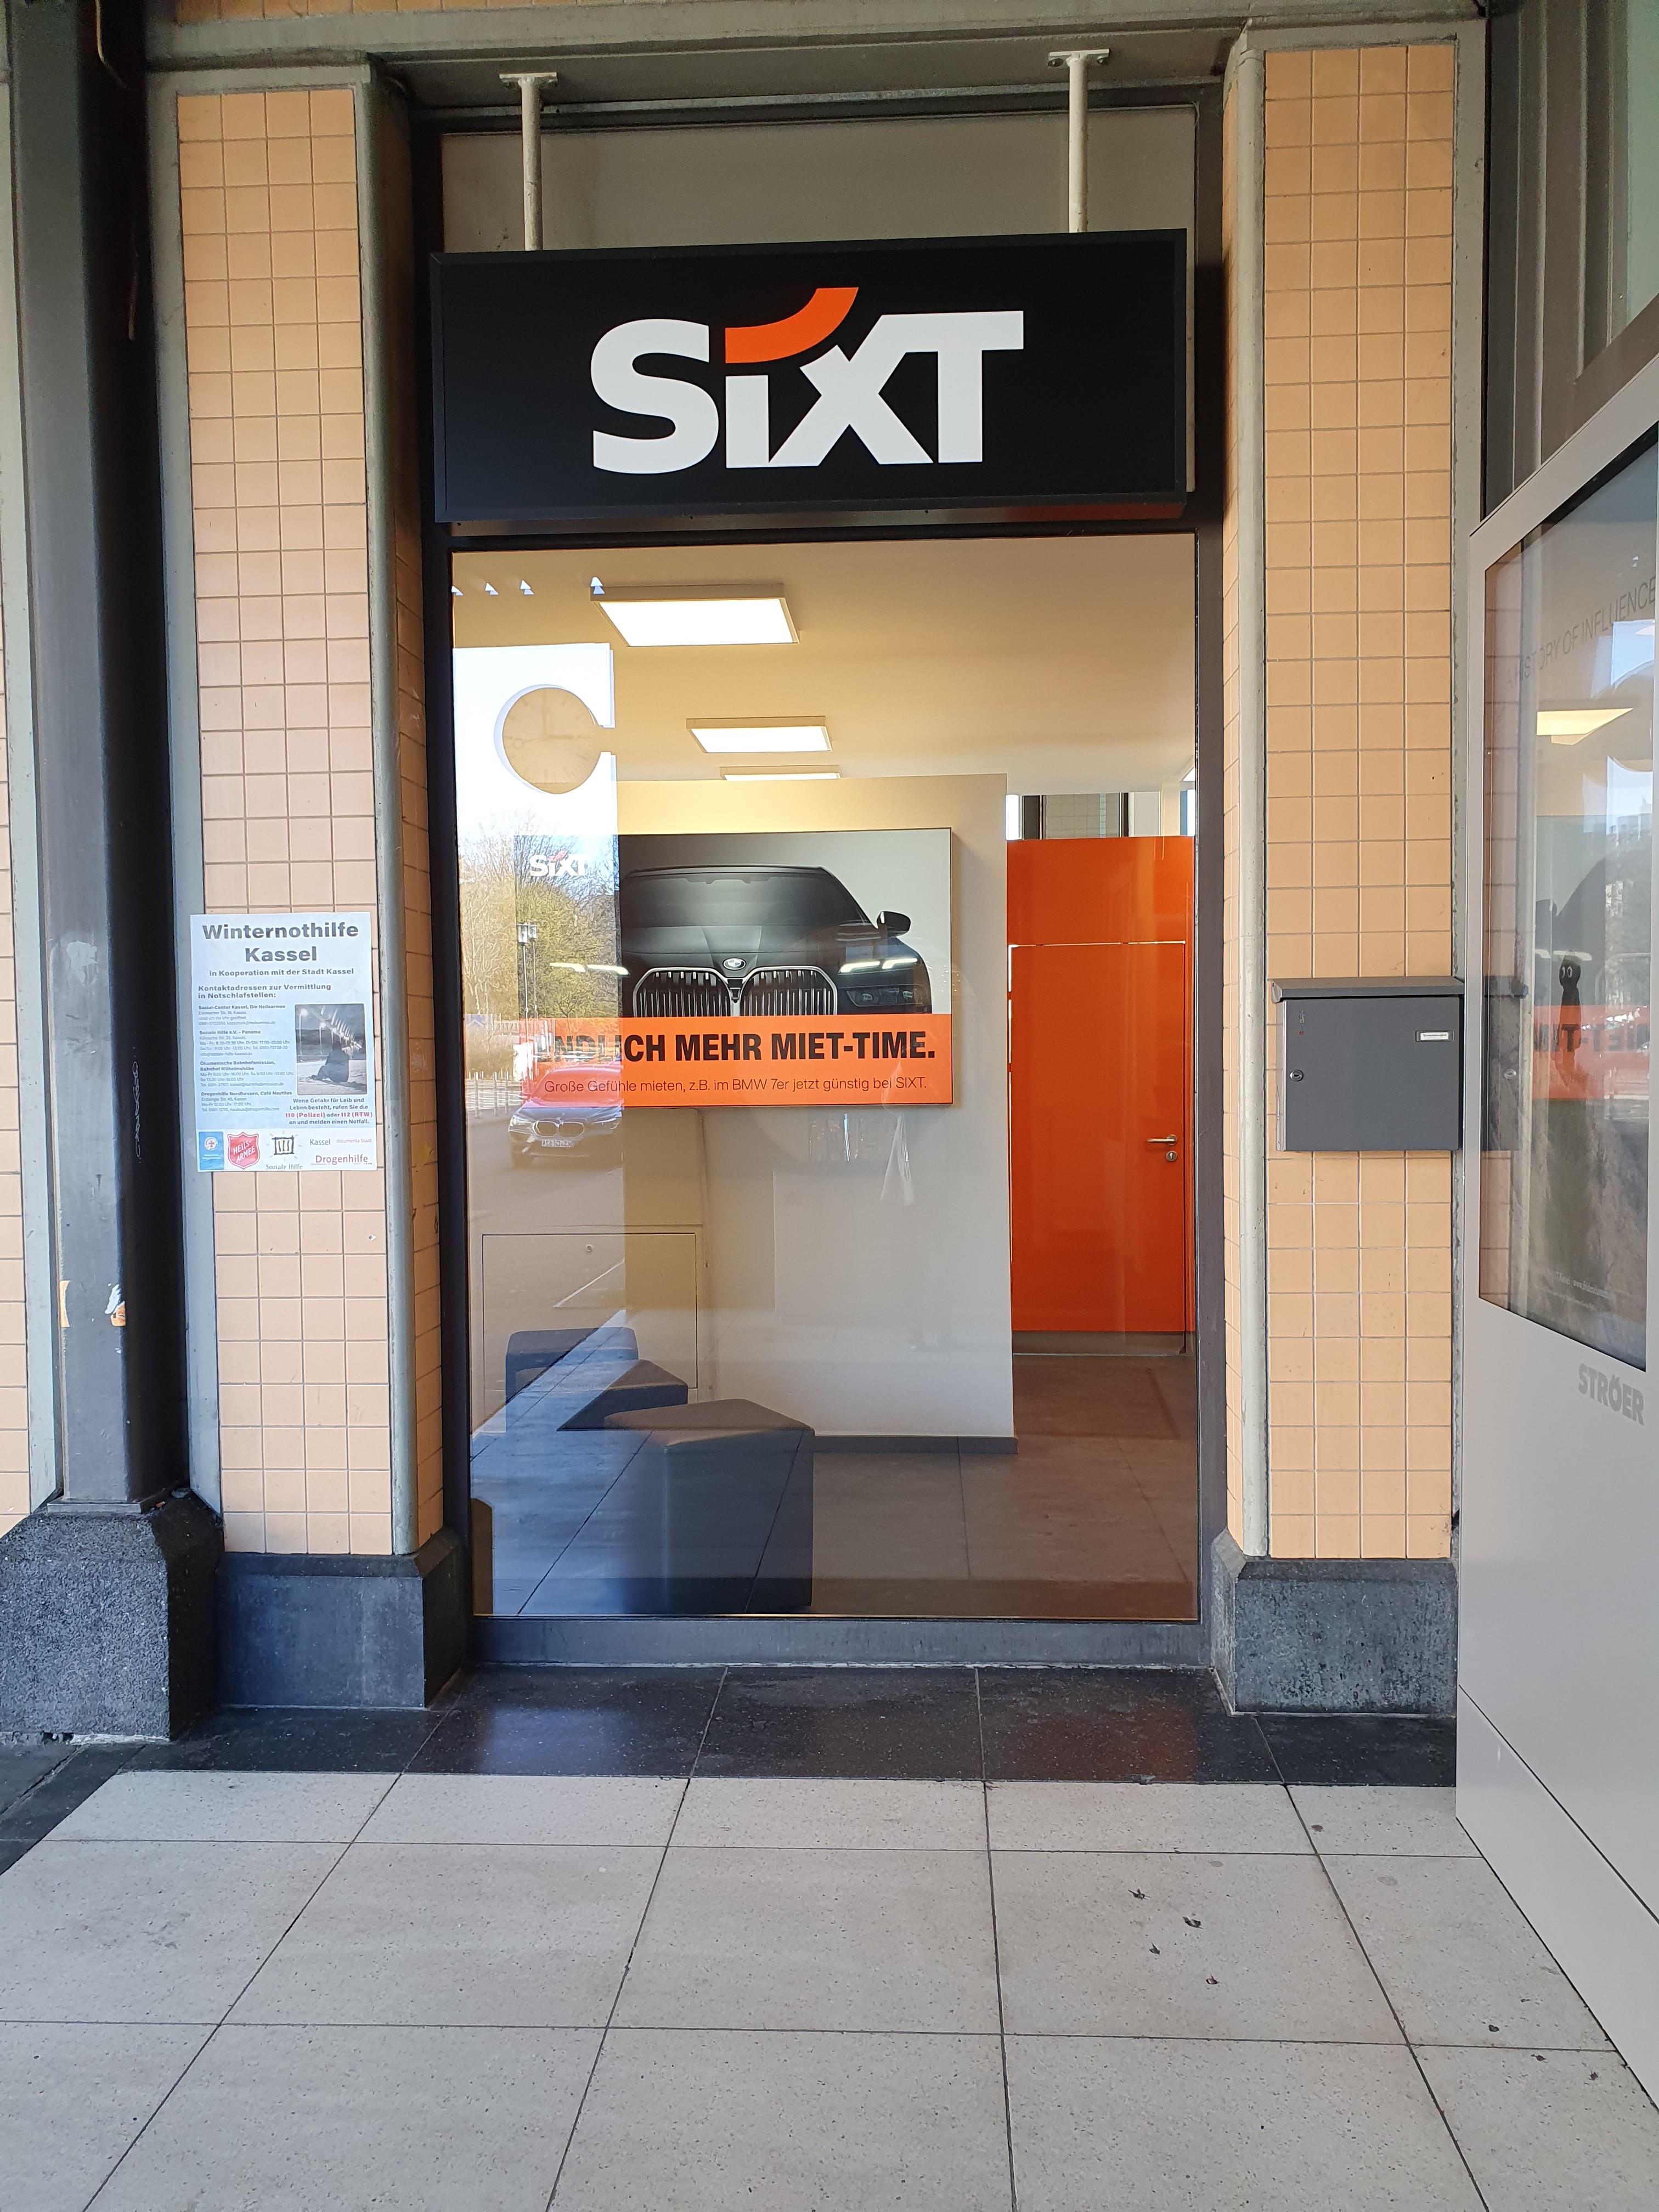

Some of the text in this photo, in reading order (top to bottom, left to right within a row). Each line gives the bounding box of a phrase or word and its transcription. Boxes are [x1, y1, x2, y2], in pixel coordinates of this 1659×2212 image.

[1563, 624, 1578, 654] OF
[1582, 575, 1656, 644] INFLUENCE
[202, 922, 359, 939] Winternothilfe
[245, 946, 317, 962] Kassel
[219, 969, 269, 978] Kooperation
[675, 1034, 761, 1061] MEHR
[771, 1031, 935, 1060] MIET-TIME.
[544, 1076, 927, 1093] Große Gefühle mieten, z.B. im BMW 7er jetzt günstig bei SIXT.
[233, 1139, 251, 1155] HEILS-
[236, 1146, 256, 1163] ARMEE
[315, 1154, 368, 1165] Drogenhilfe
[1578, 1363, 1644, 1426] STRÖER
